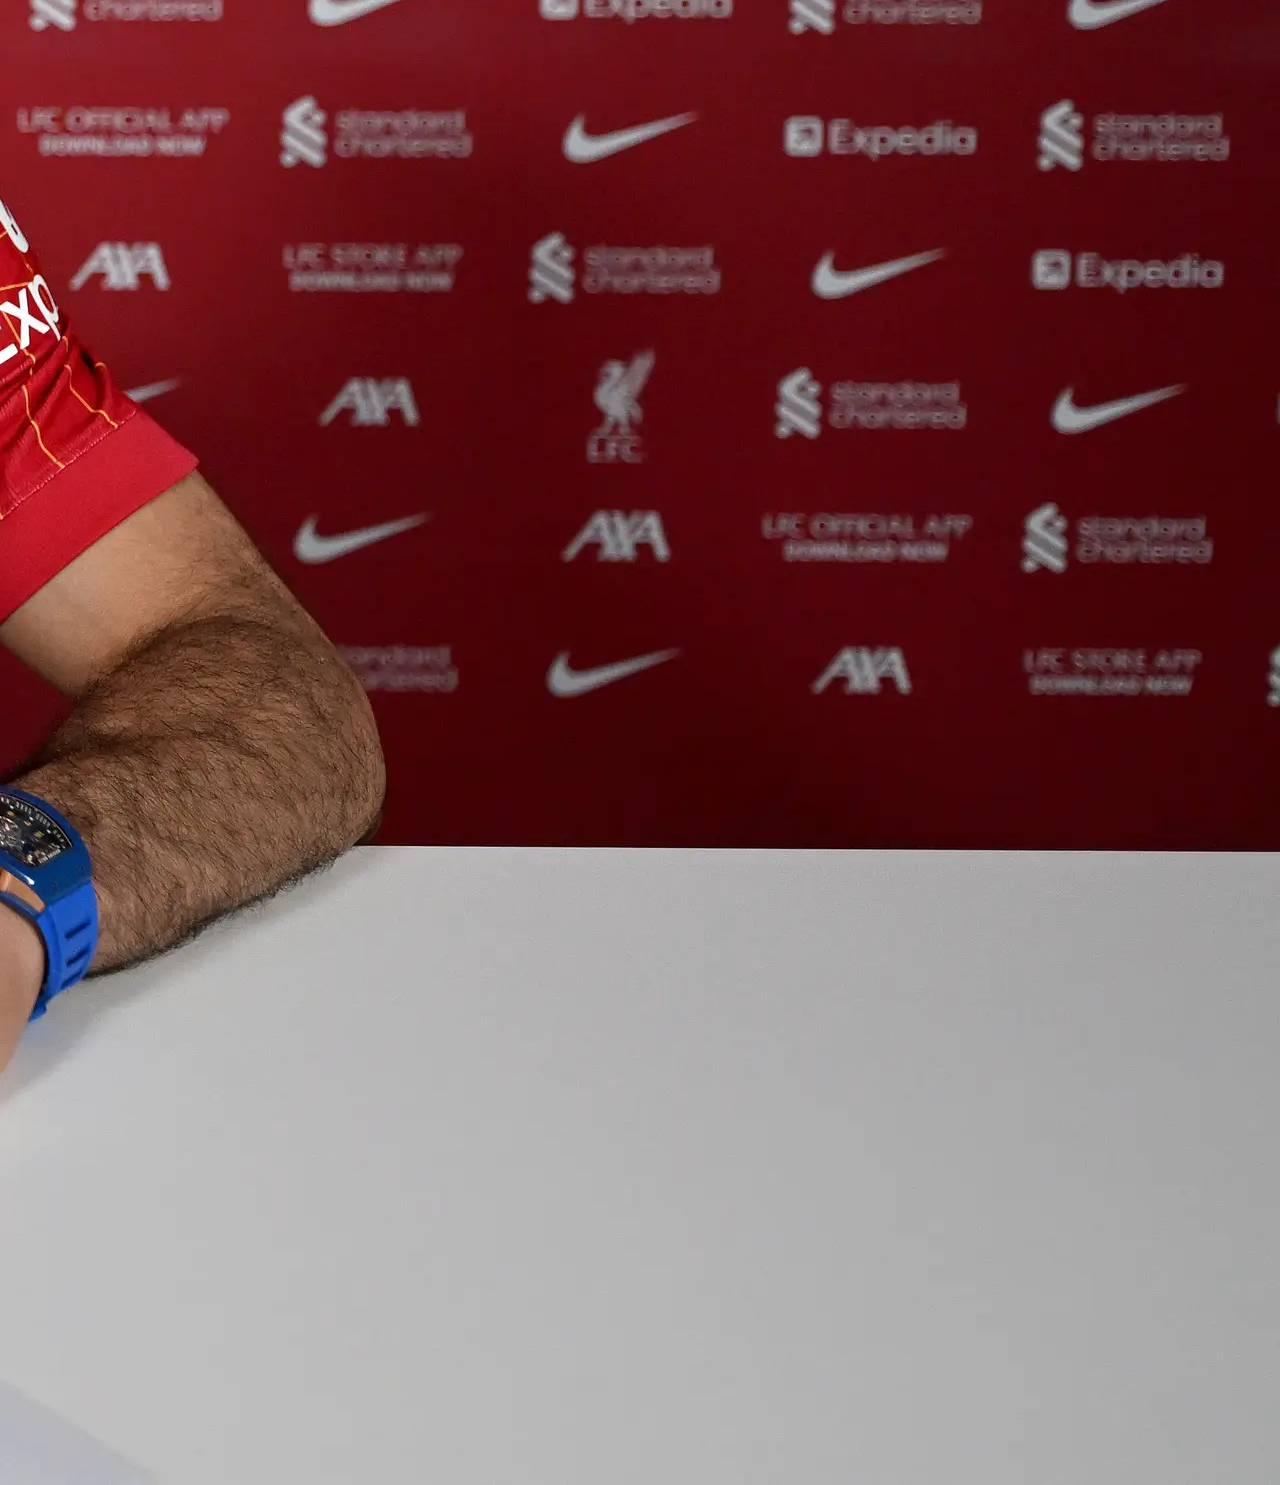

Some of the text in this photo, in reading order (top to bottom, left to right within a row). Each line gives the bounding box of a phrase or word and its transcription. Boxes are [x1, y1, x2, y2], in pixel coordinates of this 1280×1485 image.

[829, 120, 978, 158] Expedia
[69, 241, 171, 291] AXA
[1076, 253, 1225, 291] Expedia
[319, 378, 419, 426] AXA
[563, 510, 670, 562] AXA
[812, 647, 912, 694] AXA
